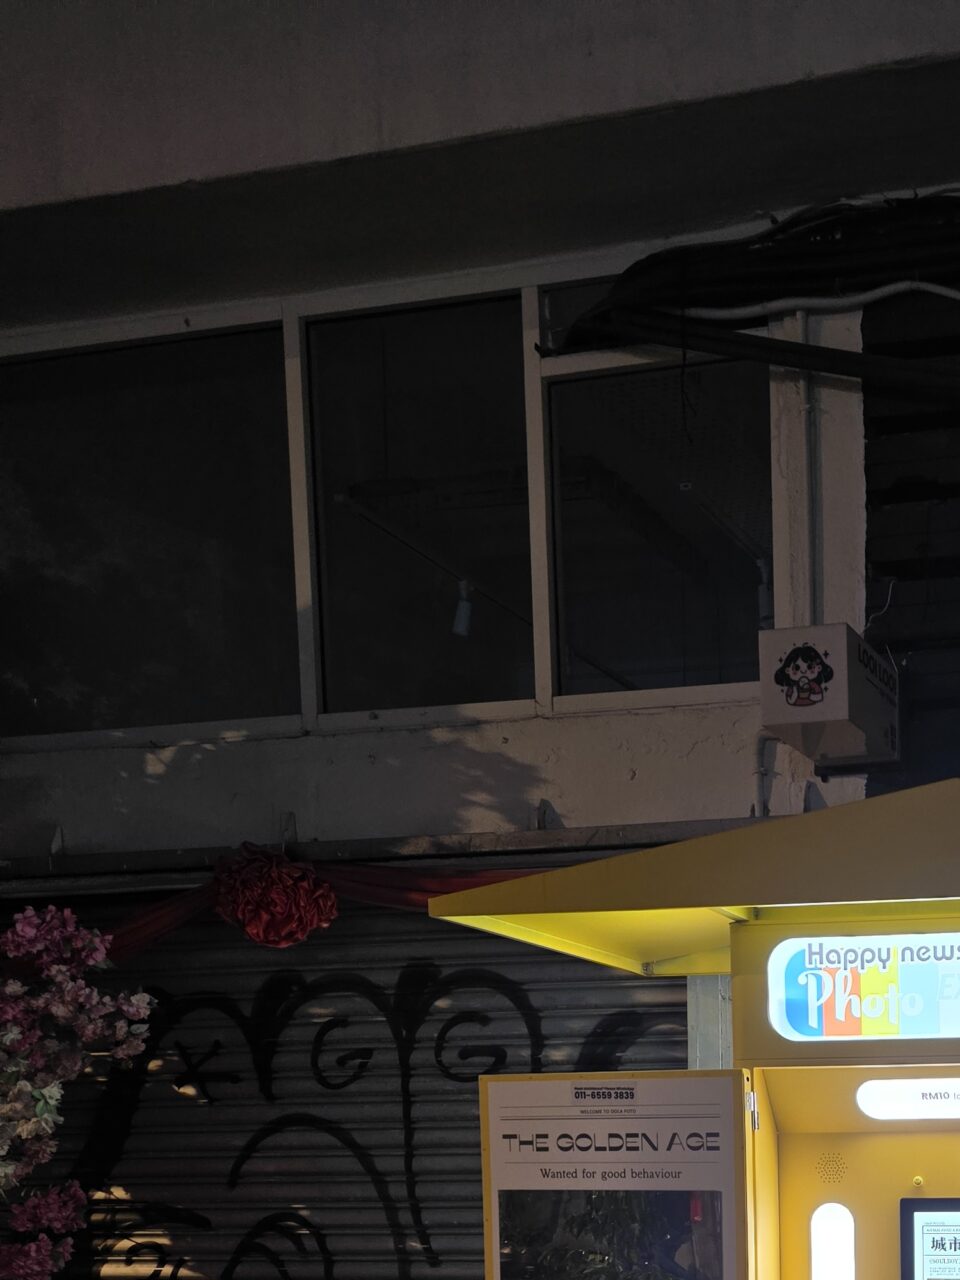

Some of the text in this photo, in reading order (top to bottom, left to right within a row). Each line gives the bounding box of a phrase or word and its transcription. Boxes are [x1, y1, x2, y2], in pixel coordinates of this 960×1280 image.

[807, 942, 891, 971] Happy
[798, 968, 926, 1031] Photo
[574, 1091, 635, 1100] 011-6559 3839
[921, 1091, 950, 1101] RM10
[502, 1132, 721, 1152] THE GOLDEN AGE
[540, 1168, 683, 1182] Wanted for good behaviour
